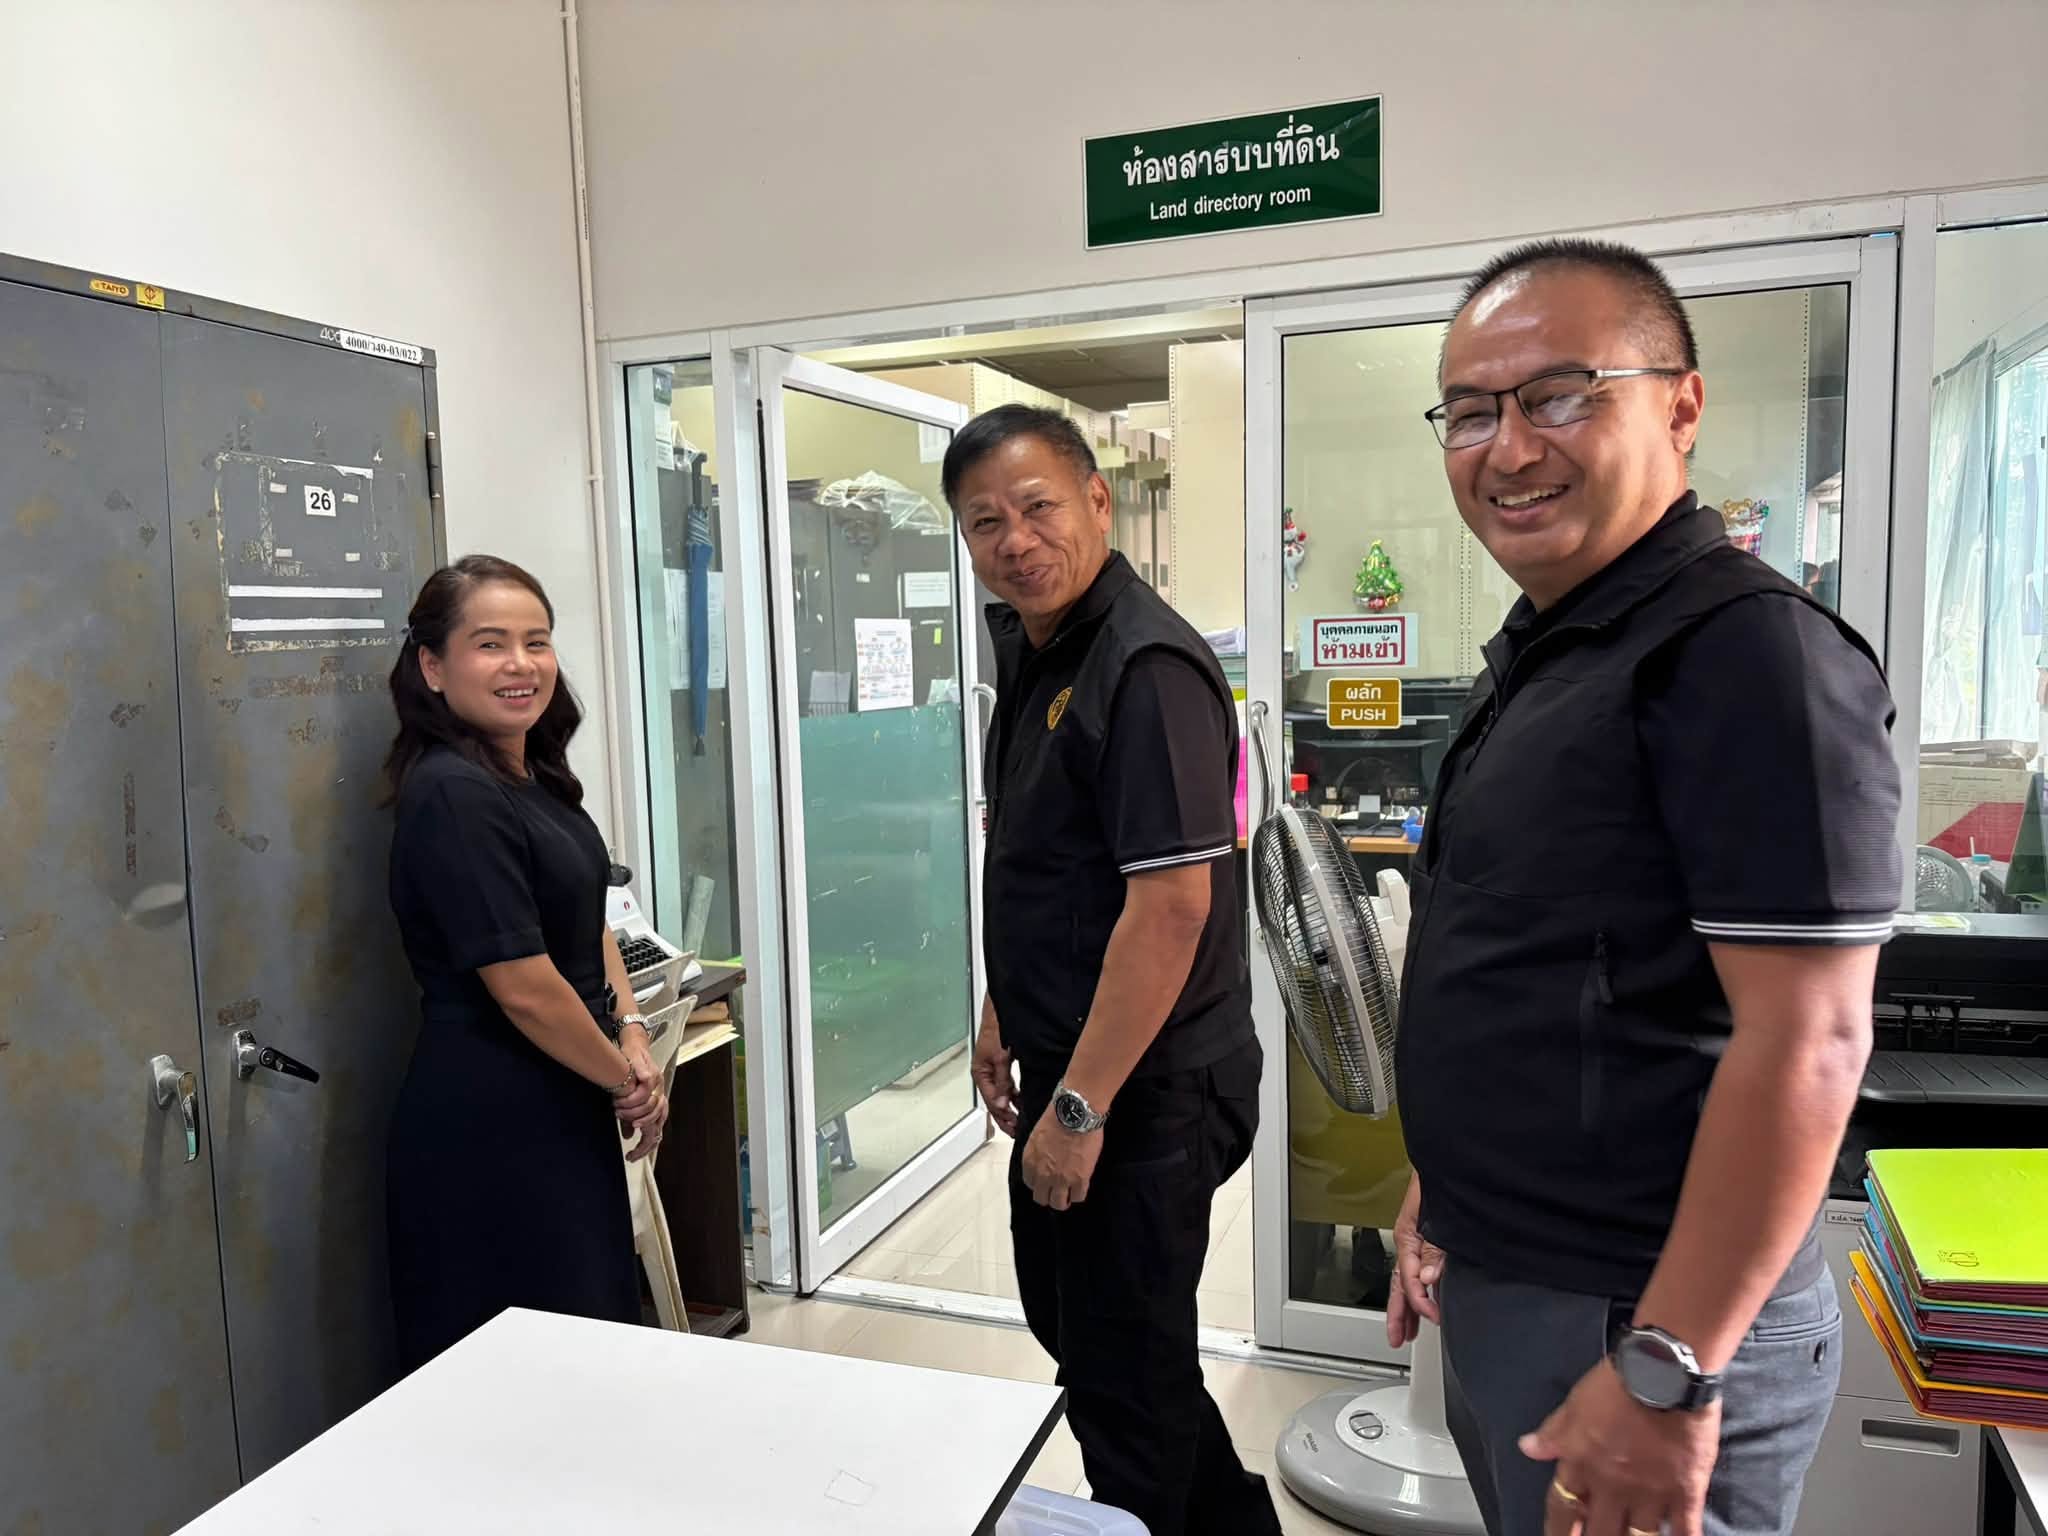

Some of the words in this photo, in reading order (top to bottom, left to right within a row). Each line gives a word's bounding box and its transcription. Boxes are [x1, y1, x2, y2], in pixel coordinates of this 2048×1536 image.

[1122, 115, 1340, 187] ห้องสารบบที่ดิน
[1150, 199, 1187, 221] Land
[1194, 192, 1263, 215] directory
[1270, 186, 1311, 206] room
[310, 492, 331, 510] 26
[1321, 624, 1398, 639] บุคคลภายนอก
[1321, 635, 1398, 659] ห้ามเข้า
[1346, 682, 1381, 700] ผลัก
[1341, 708, 1386, 721] PUSH
